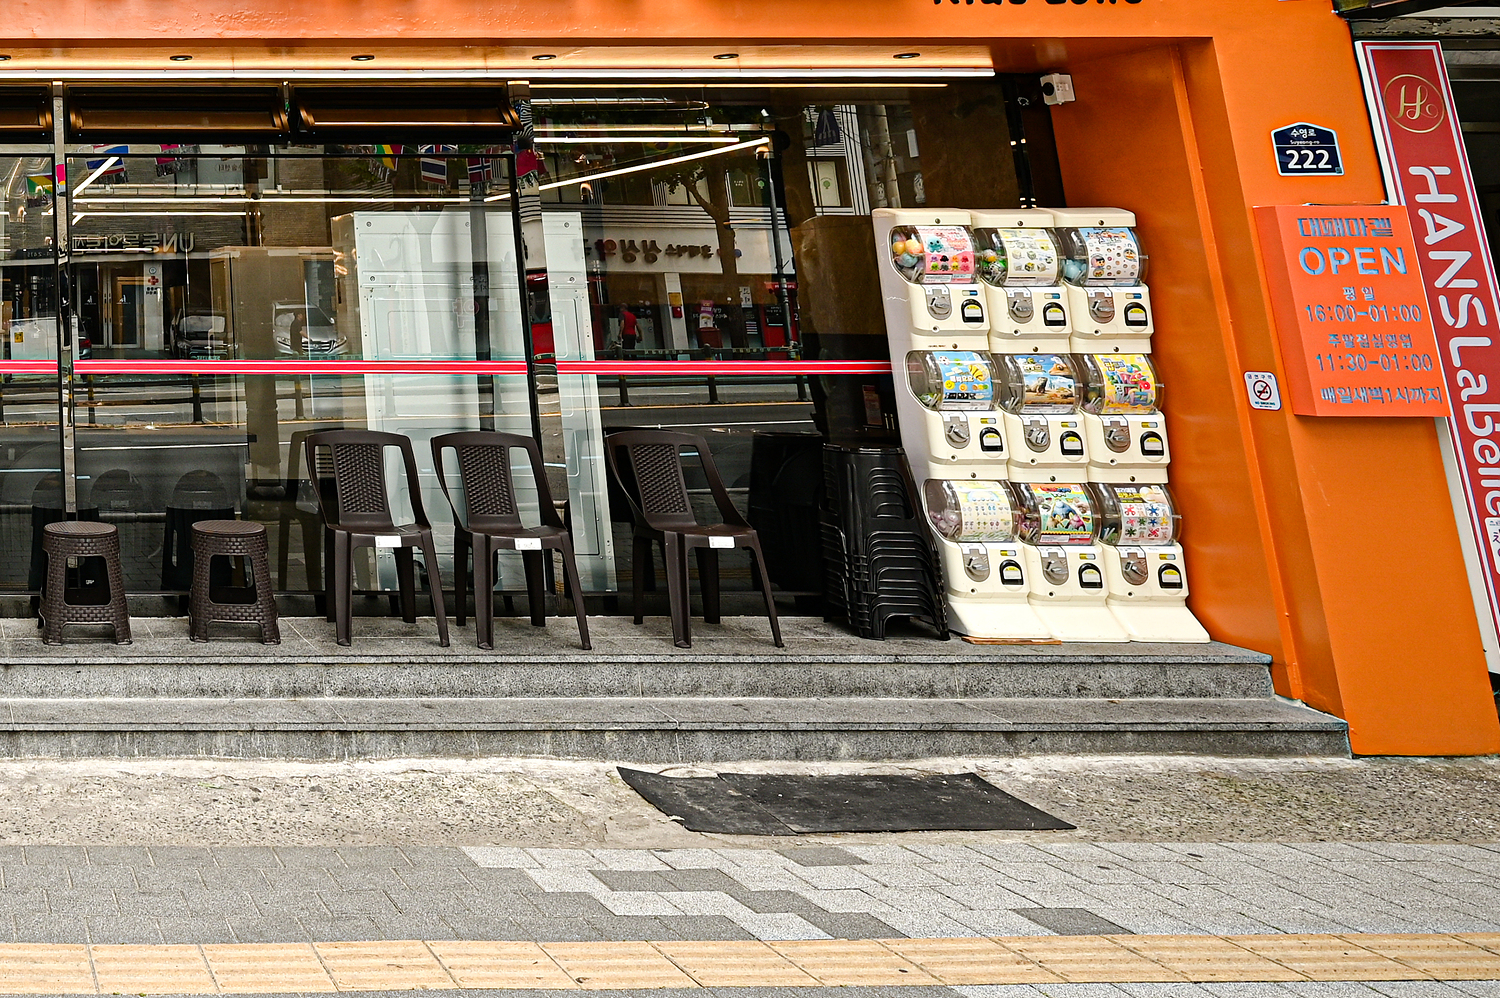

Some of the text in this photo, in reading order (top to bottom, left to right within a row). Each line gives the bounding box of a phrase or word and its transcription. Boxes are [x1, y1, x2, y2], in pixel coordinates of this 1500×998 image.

[1290, 128, 1317, 139] 수영로
[1285, 149, 1332, 169] 222
[1298, 246, 1408, 275] OPEN
[1304, 304, 1422, 322] 16:00-01:00
[1328, 333, 1413, 349] 주말점심영업
[1315, 353, 1433, 372] 11:30-01:00
